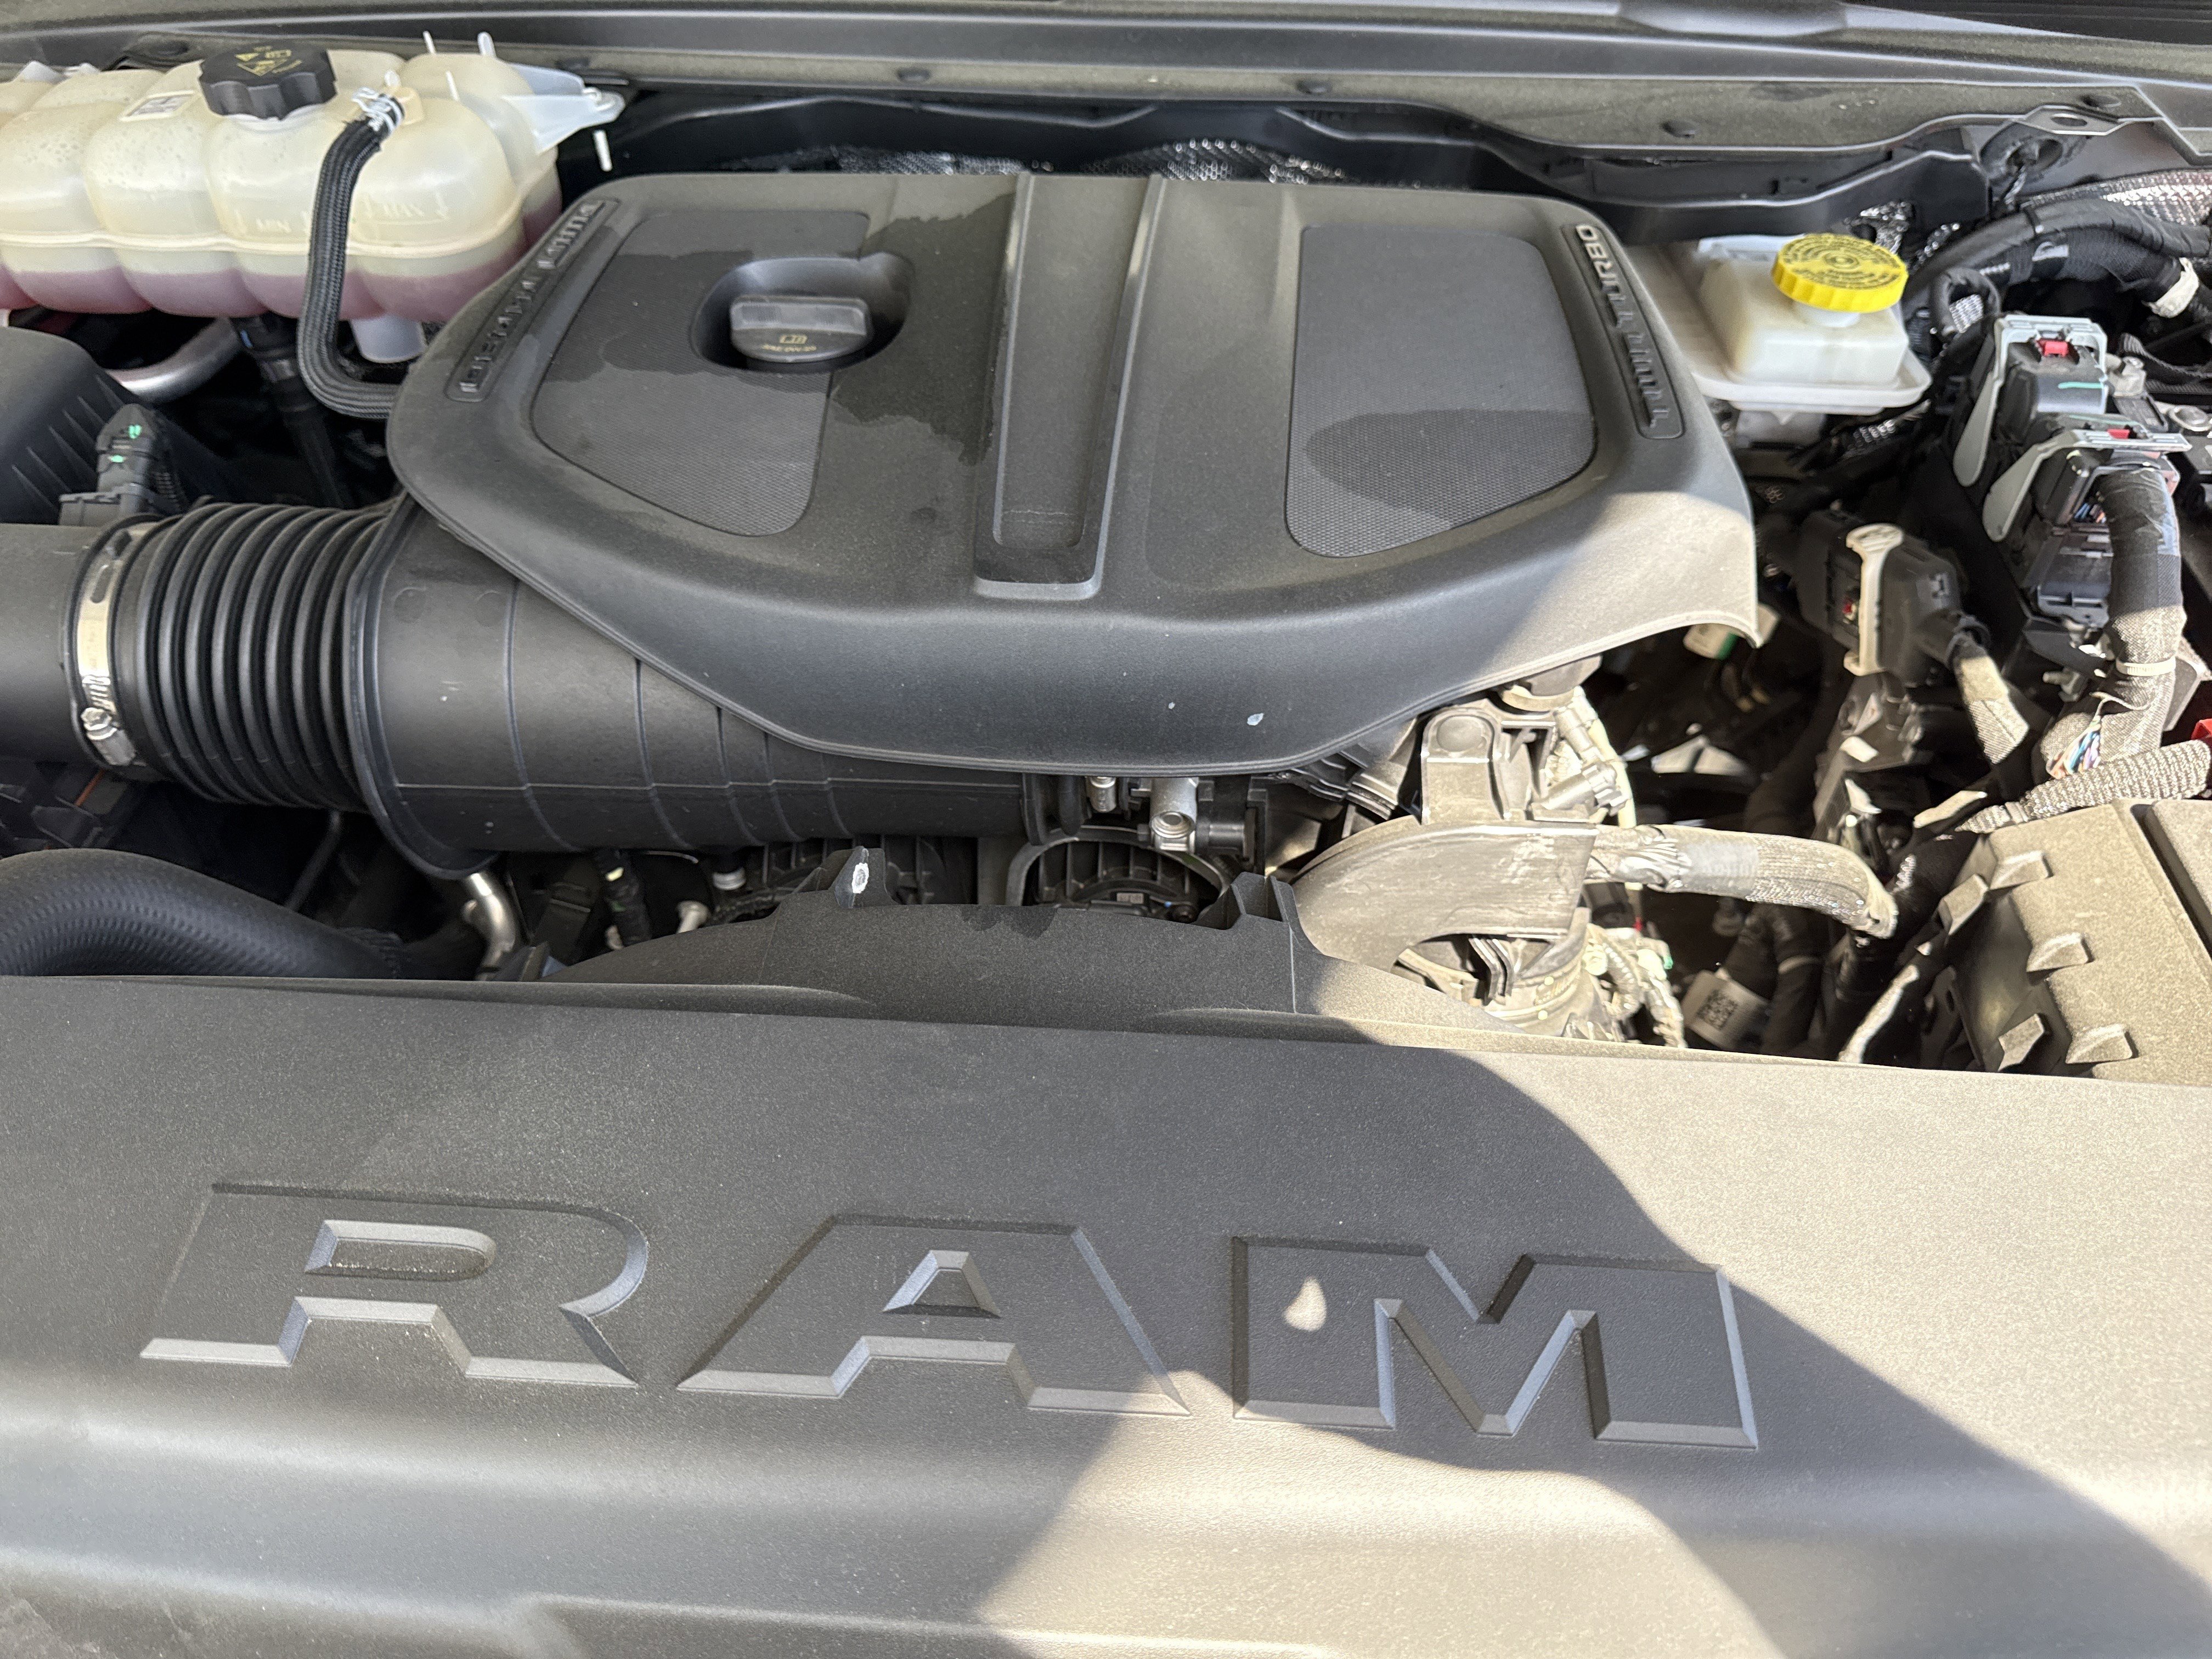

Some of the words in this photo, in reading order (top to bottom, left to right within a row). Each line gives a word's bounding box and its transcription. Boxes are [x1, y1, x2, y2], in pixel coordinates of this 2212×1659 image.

[1576, 223, 1634, 329] TURBO
[1624, 334, 1670, 428] TWIN
[139, 1181, 1759, 1452] RAM
